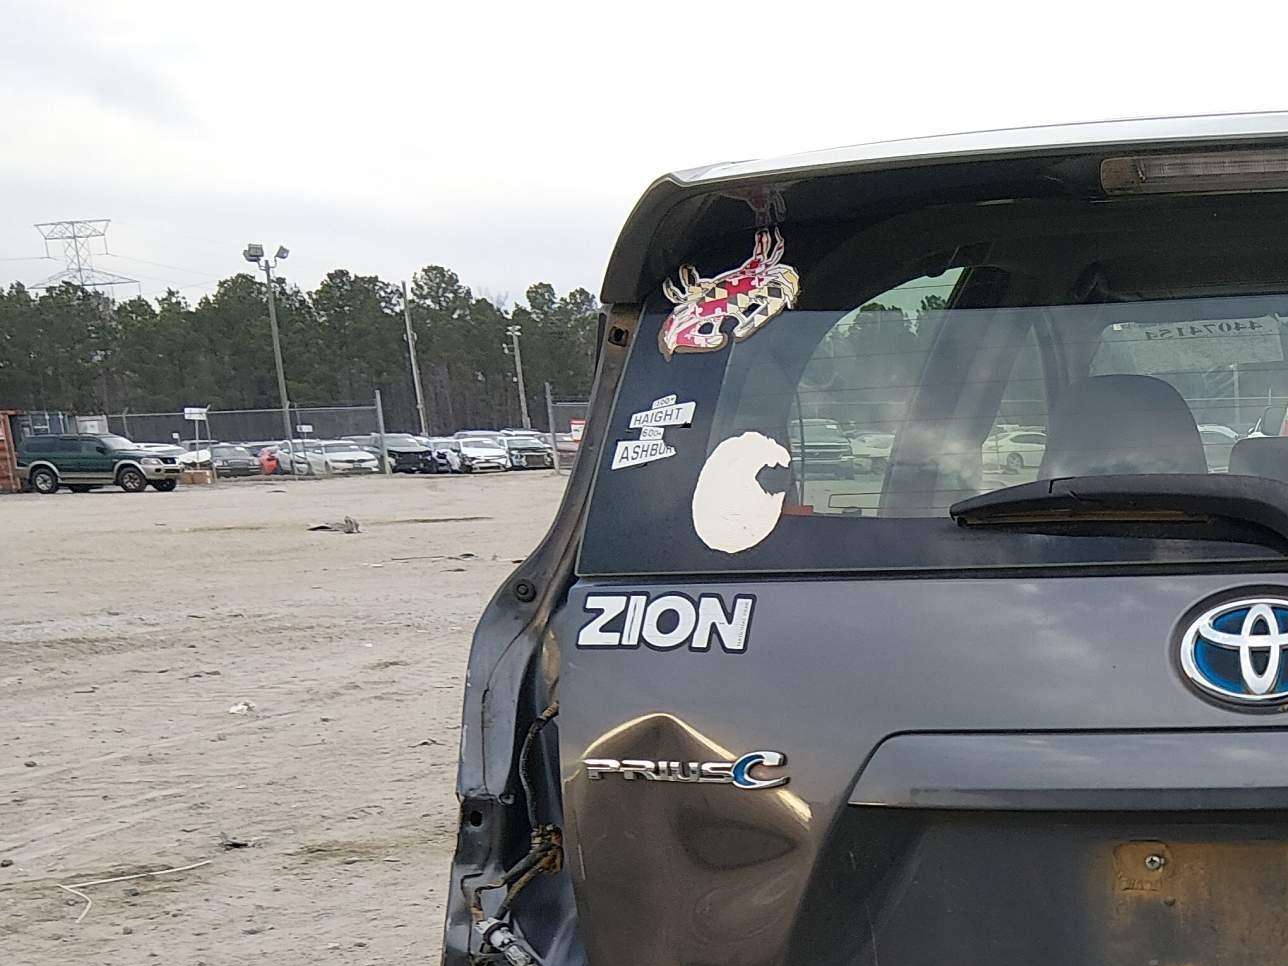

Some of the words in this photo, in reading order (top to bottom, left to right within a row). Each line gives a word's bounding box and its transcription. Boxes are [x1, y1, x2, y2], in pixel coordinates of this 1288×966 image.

[633, 407, 683, 426] HAIGHT
[577, 594, 755, 651] ZION
[585, 758, 732, 784] PRIUS
